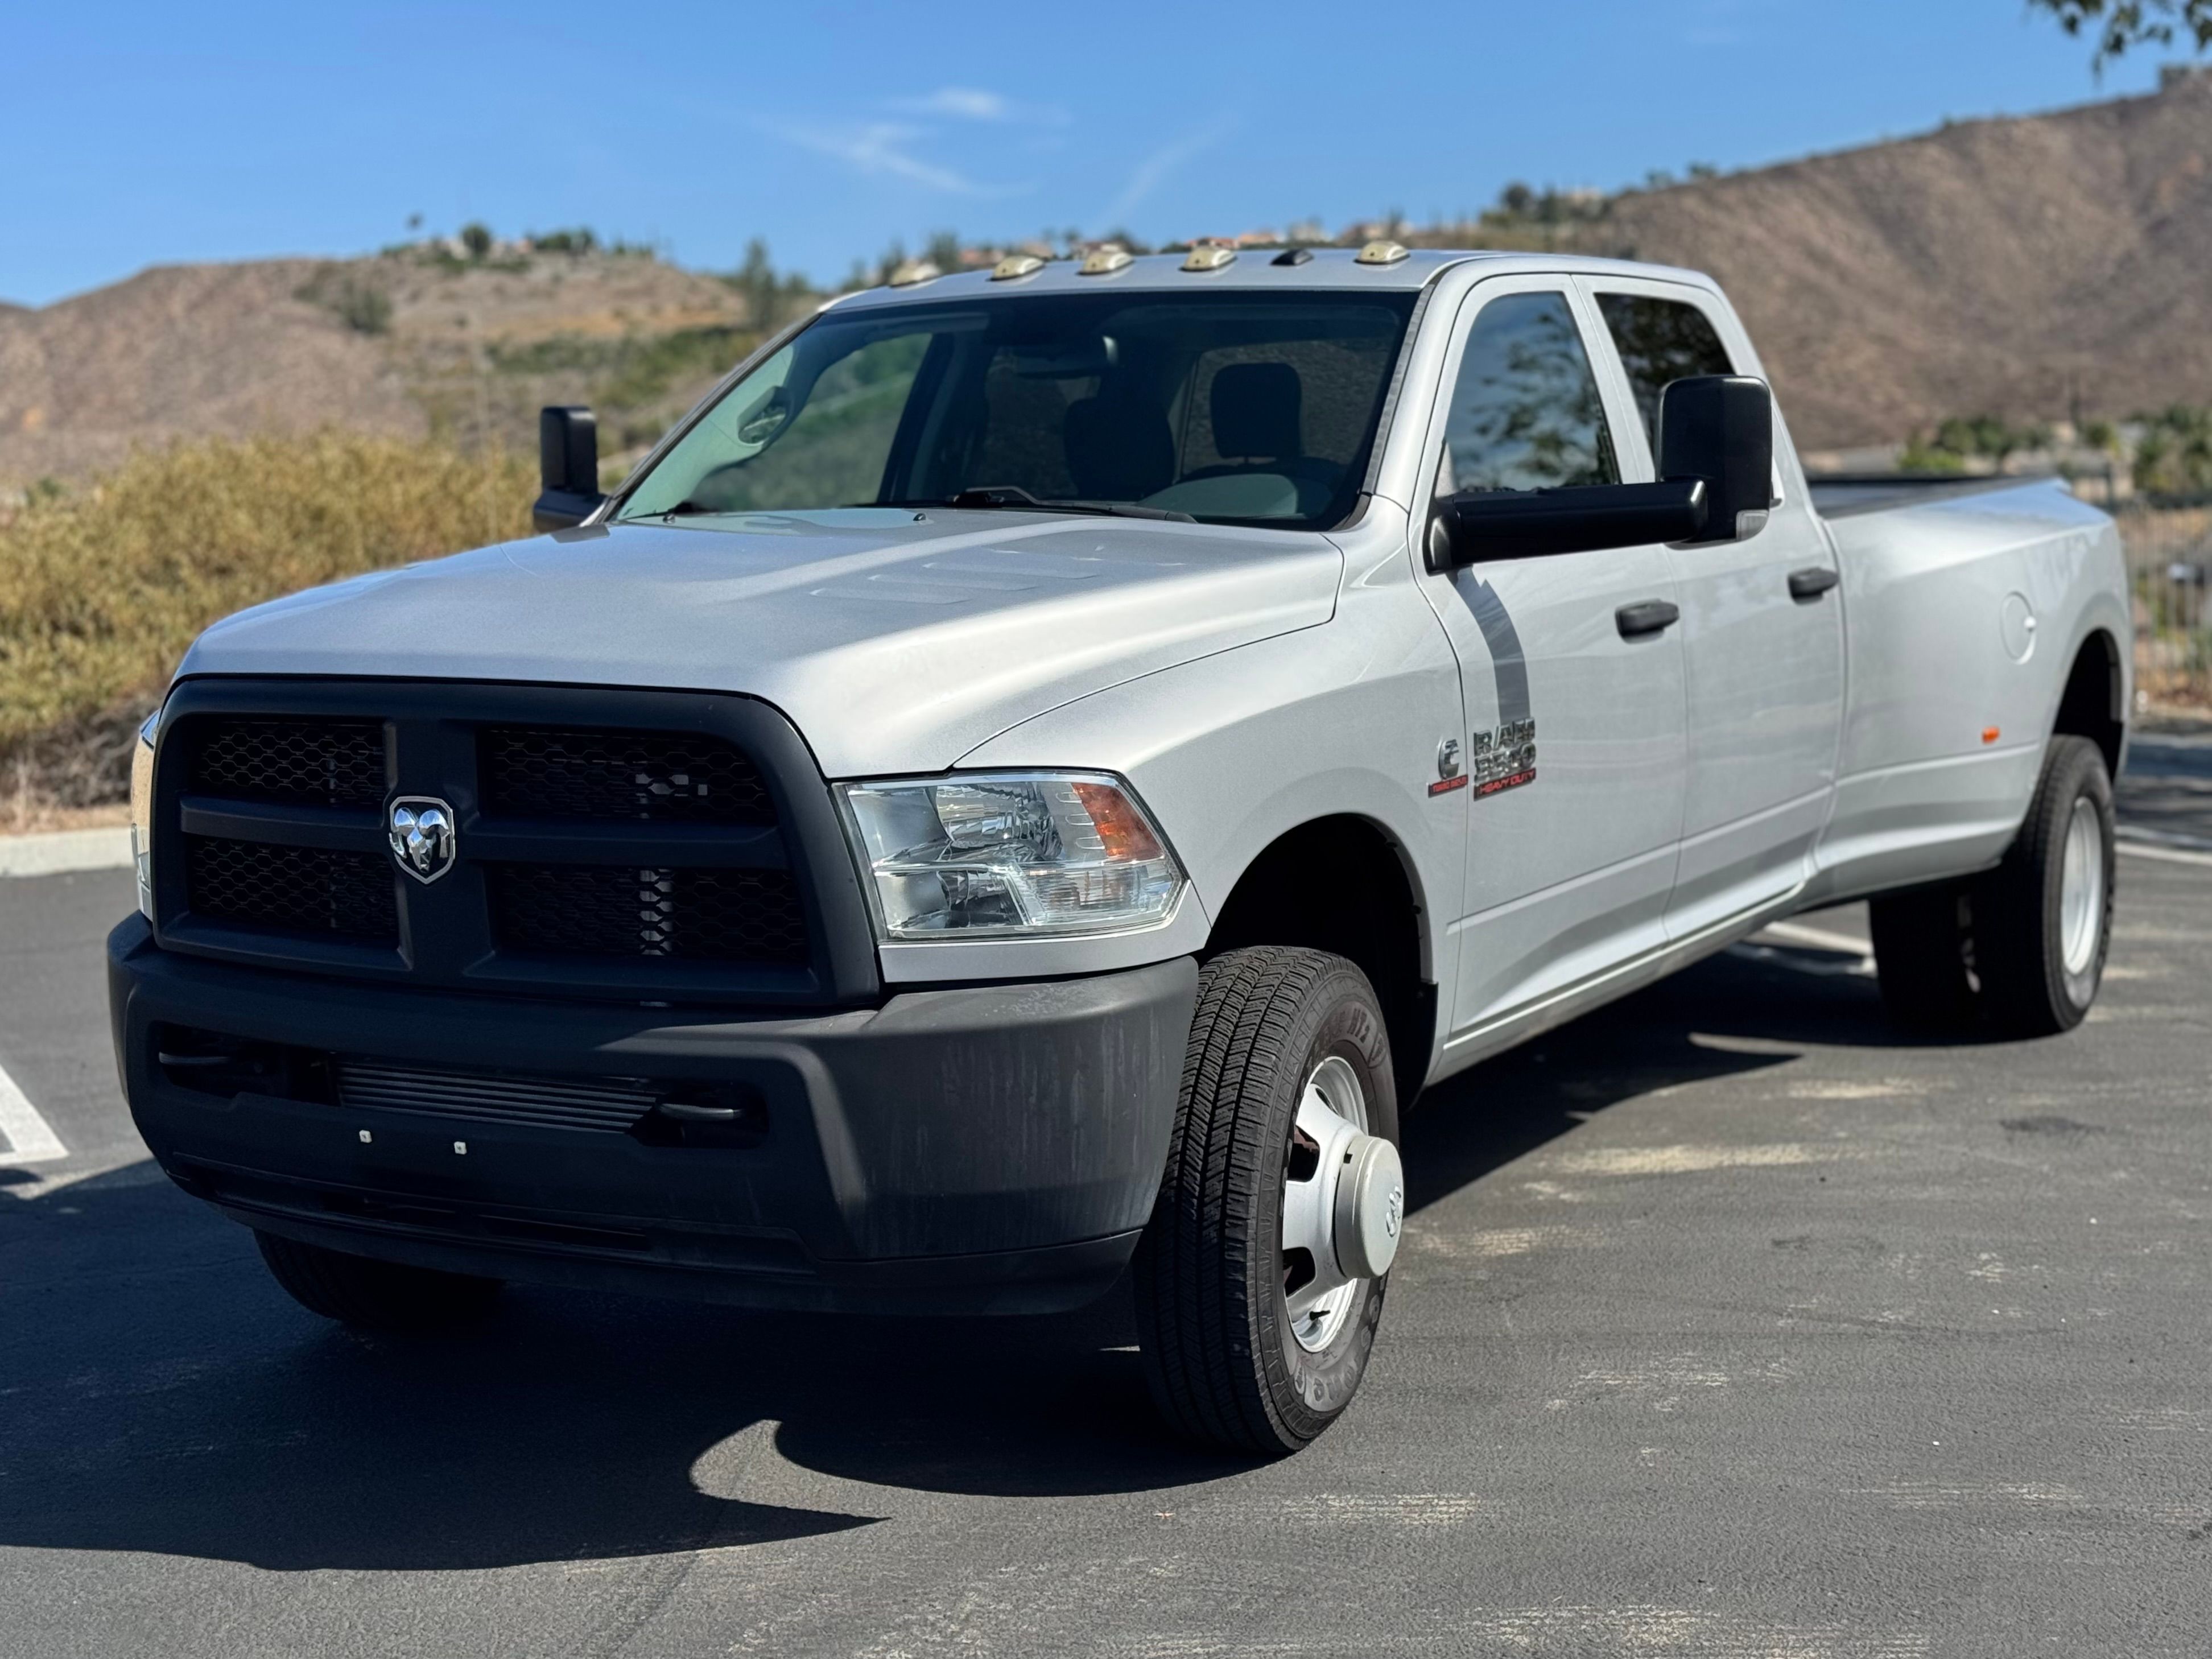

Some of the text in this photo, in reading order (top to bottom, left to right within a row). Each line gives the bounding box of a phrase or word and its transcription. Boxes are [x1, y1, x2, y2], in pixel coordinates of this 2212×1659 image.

[1474, 718, 1536, 757] RAM
[1480, 779, 1508, 794] HEAVY
[1510, 770, 1534, 785] DUTY
